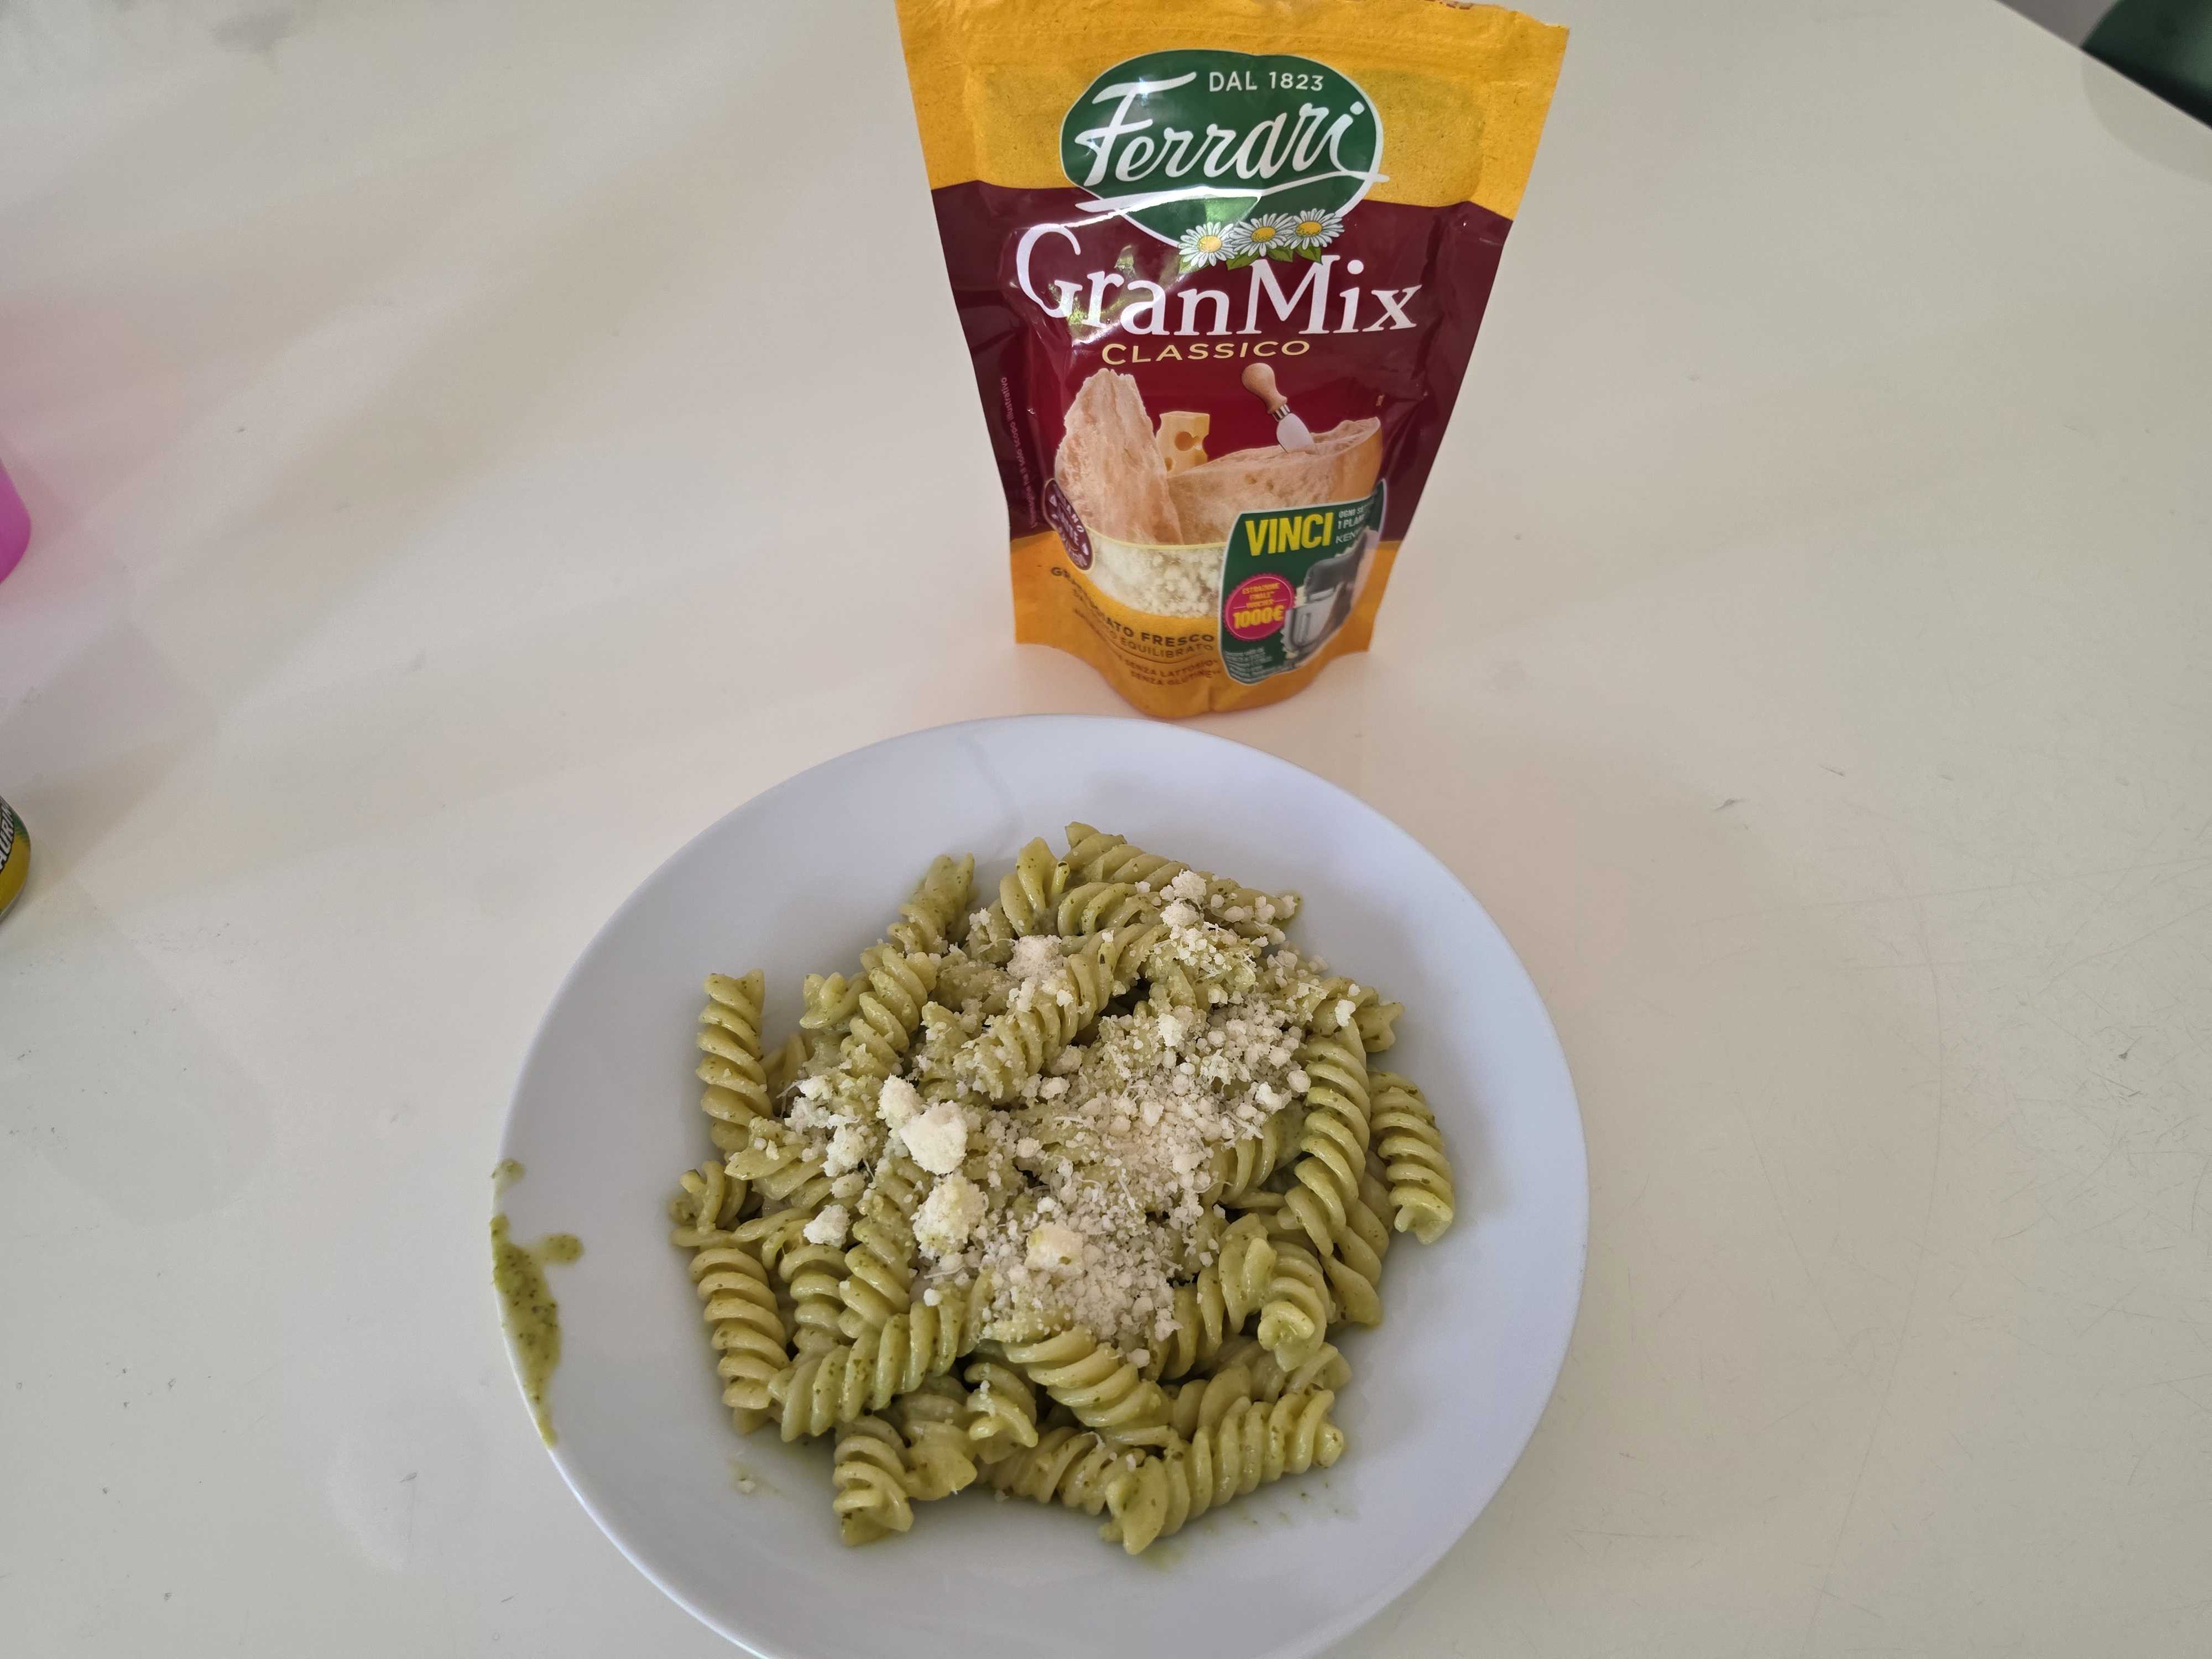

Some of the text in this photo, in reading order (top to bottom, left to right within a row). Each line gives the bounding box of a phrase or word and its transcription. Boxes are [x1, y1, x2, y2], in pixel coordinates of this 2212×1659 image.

[1209, 71, 1324, 92] DAL 1823
[1074, 72, 1390, 191] Ferrari
[1015, 223, 1422, 336] GranMix
[1102, 340, 1311, 365] CLASSICO
[1245, 512, 1334, 556] VINCI
[1338, 520, 1342, 529] 1
[1233, 605, 1285, 629] 1000€
[1120, 637, 1213, 658] EQUILIBRATO
[1141, 632, 1215, 647] FRESCO
